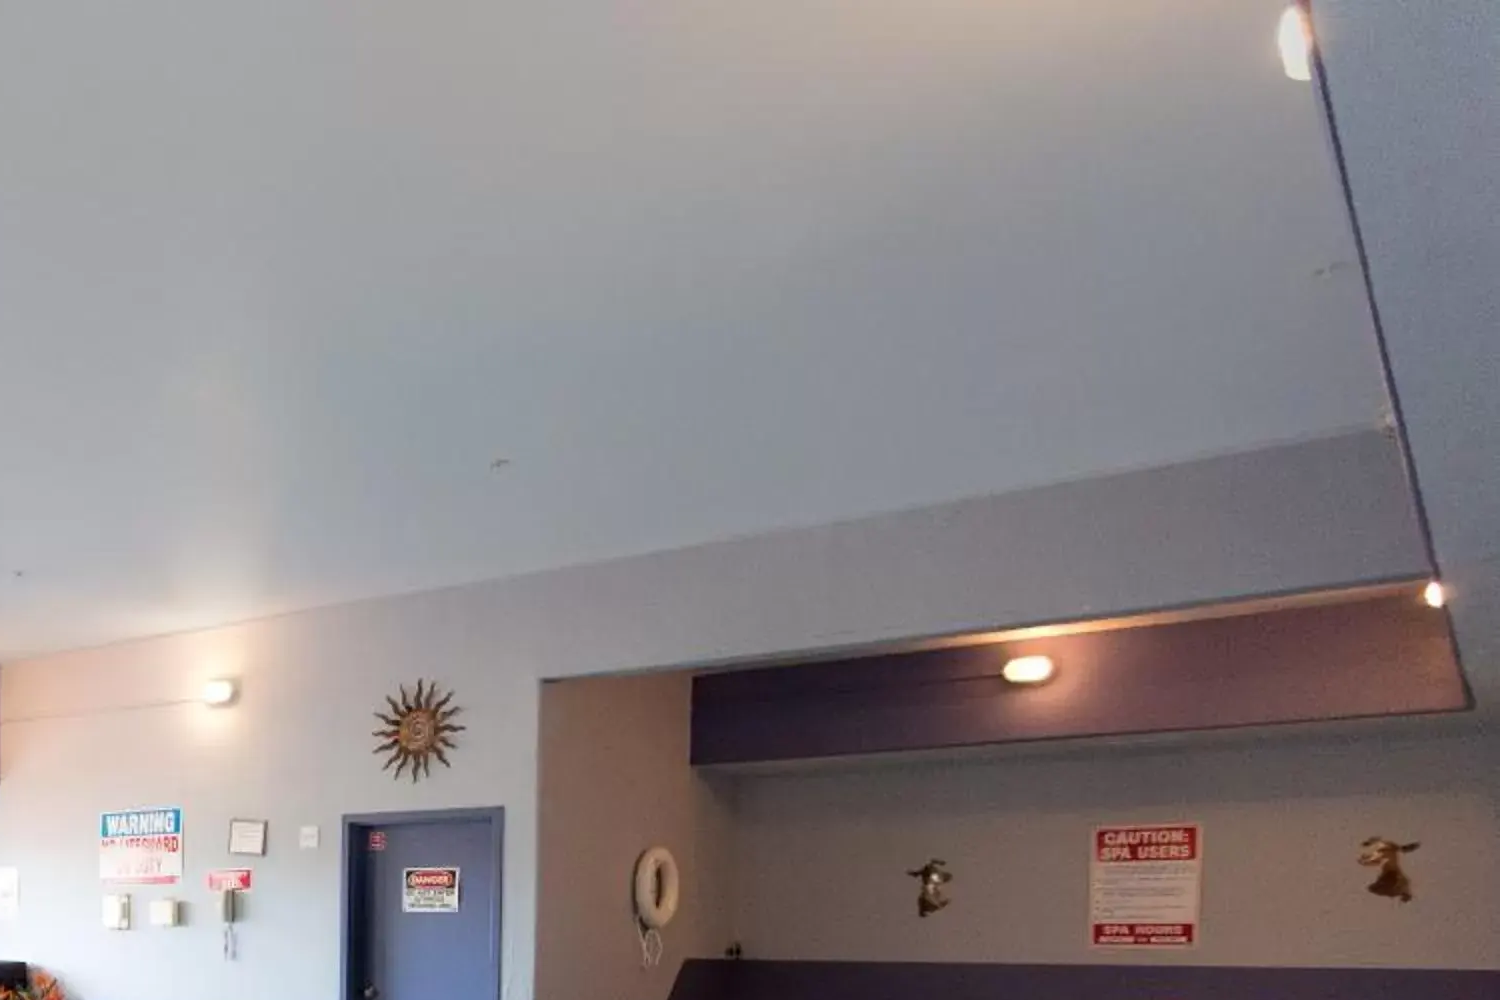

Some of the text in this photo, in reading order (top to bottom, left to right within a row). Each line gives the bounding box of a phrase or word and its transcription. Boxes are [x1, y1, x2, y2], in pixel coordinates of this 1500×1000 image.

[106, 811, 175, 836] WARNING
[1100, 845, 1189, 860] SPA USERS
[410, 875, 449, 885] DANGER
[1103, 925, 1182, 934] SPA HOURS
